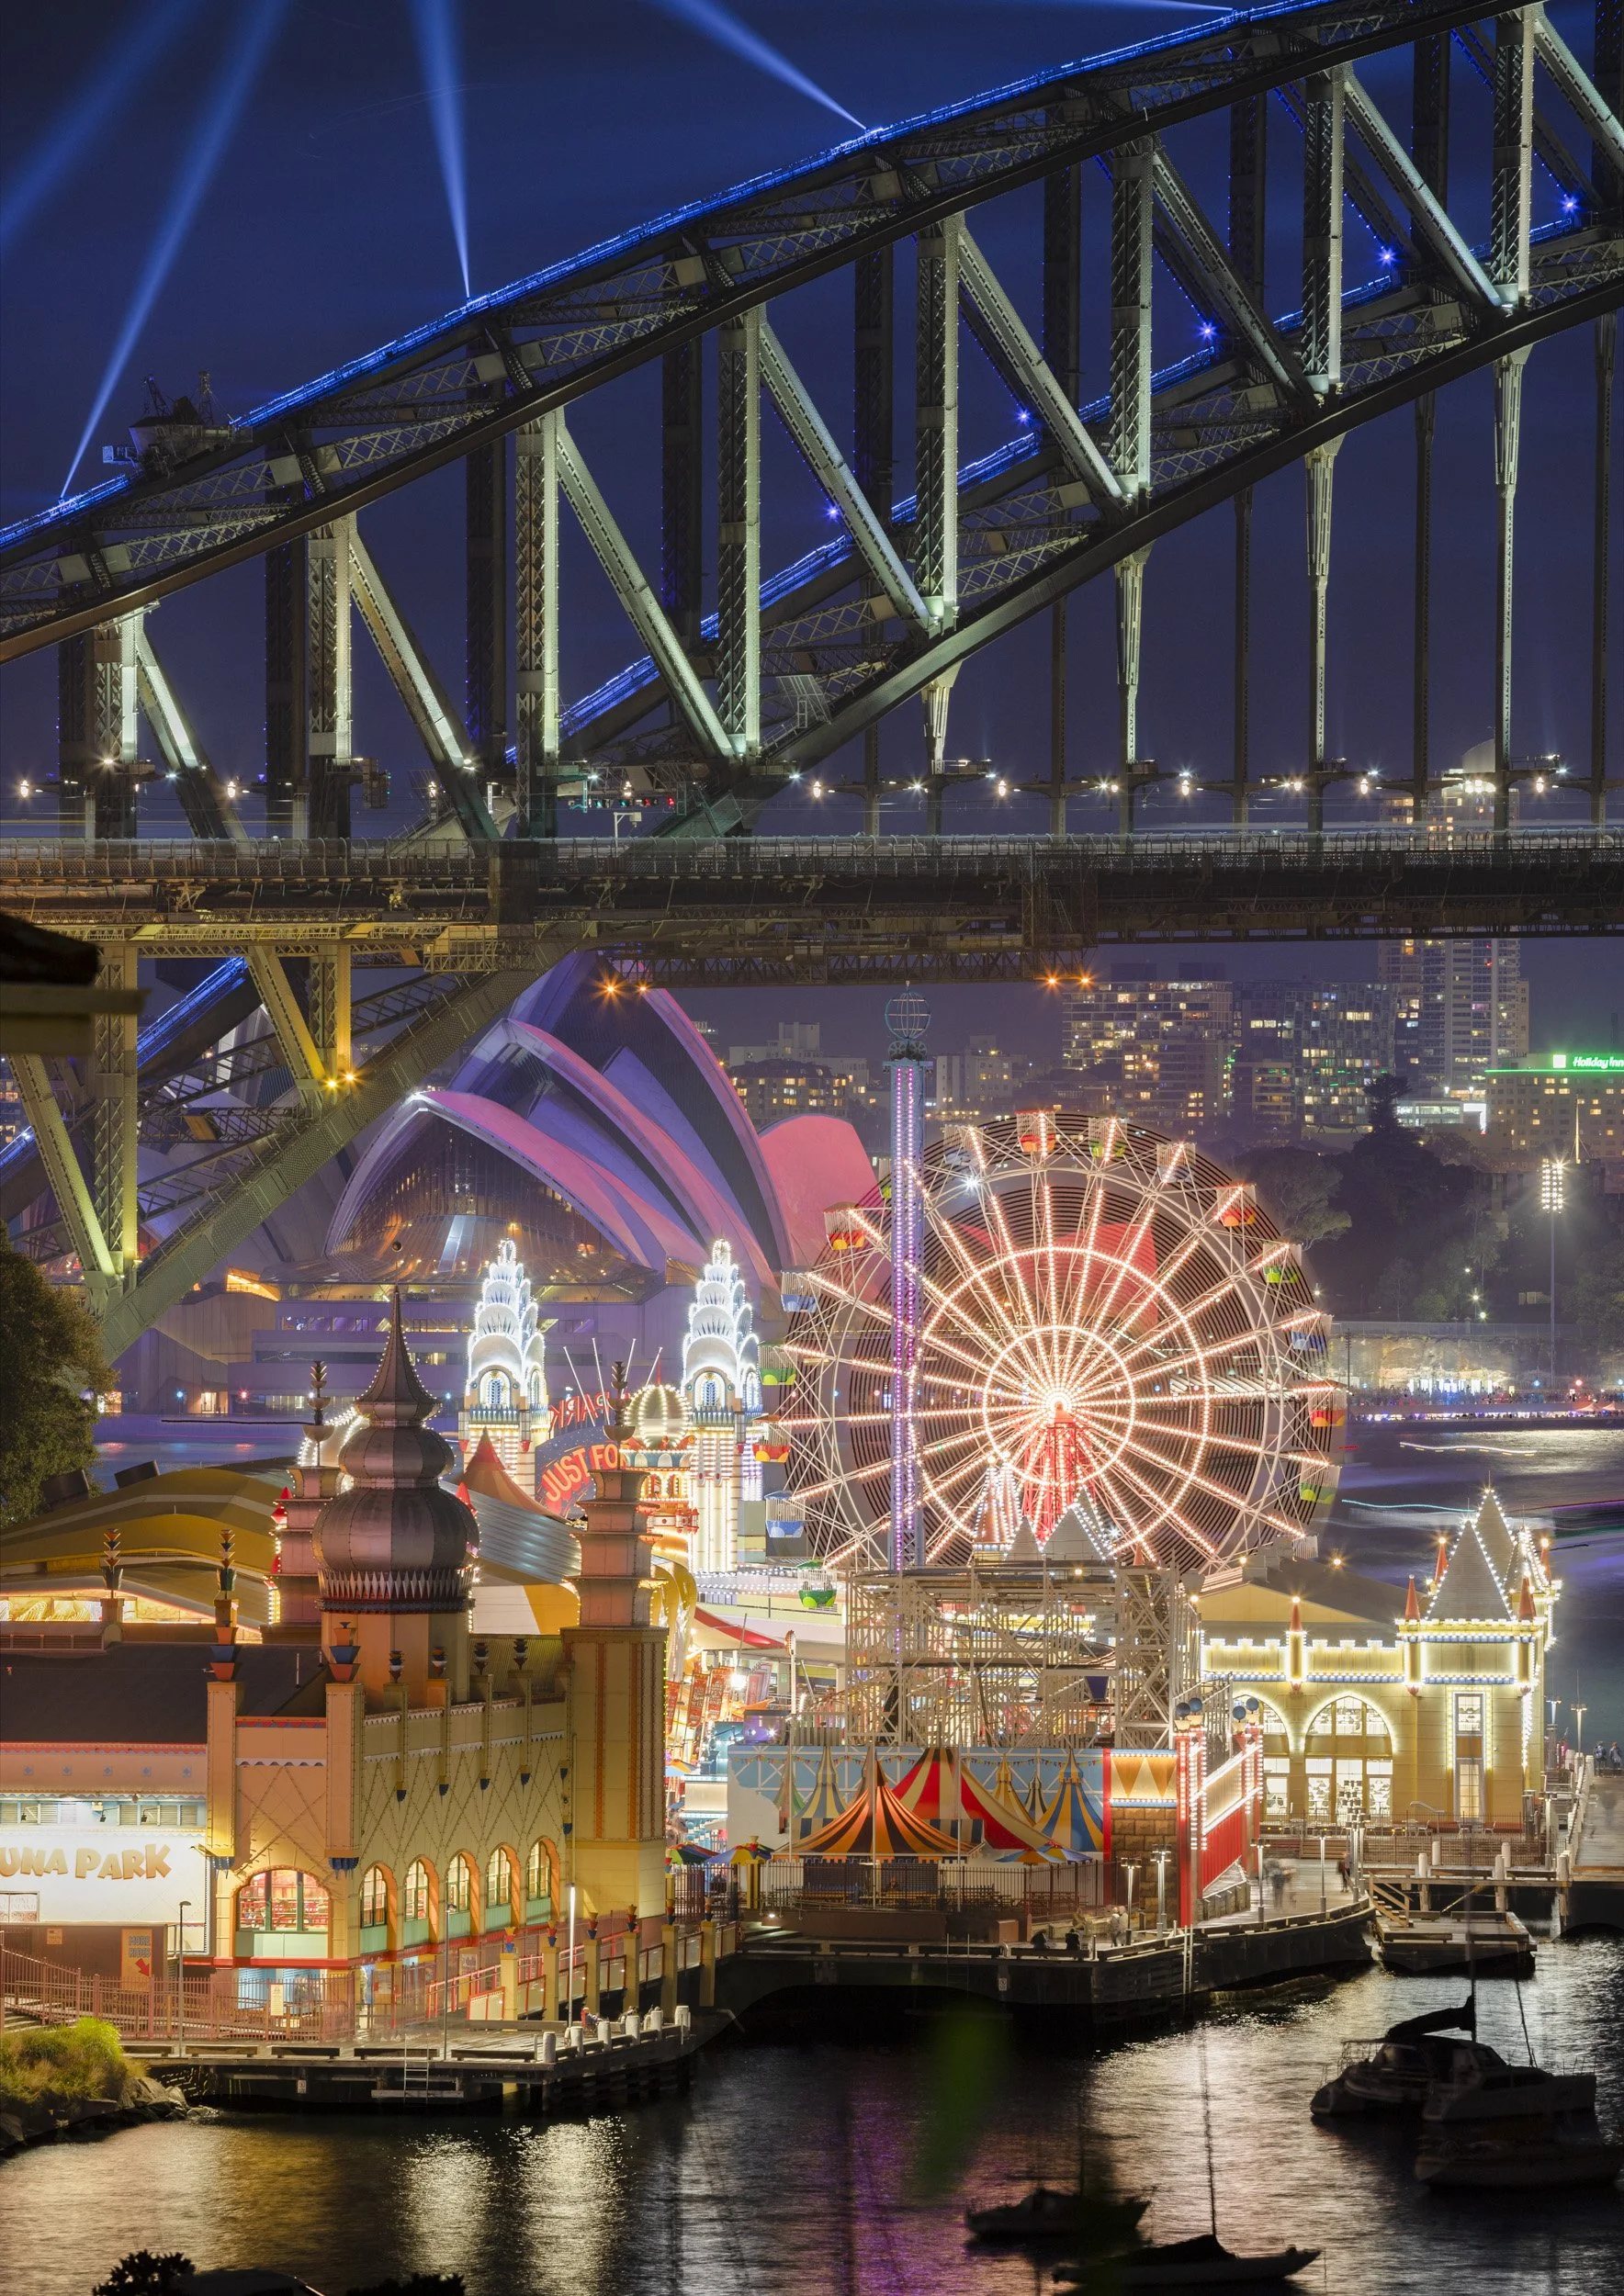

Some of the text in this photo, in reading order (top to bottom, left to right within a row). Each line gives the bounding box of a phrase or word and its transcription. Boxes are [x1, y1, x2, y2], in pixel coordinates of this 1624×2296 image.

[1573, 1056, 1624, 1069] Holiday Inn
[541, 1446, 591, 1503] JUST
[0, 1843, 172, 1880] UNA PARK
[129, 1936, 151, 1945] MORE
